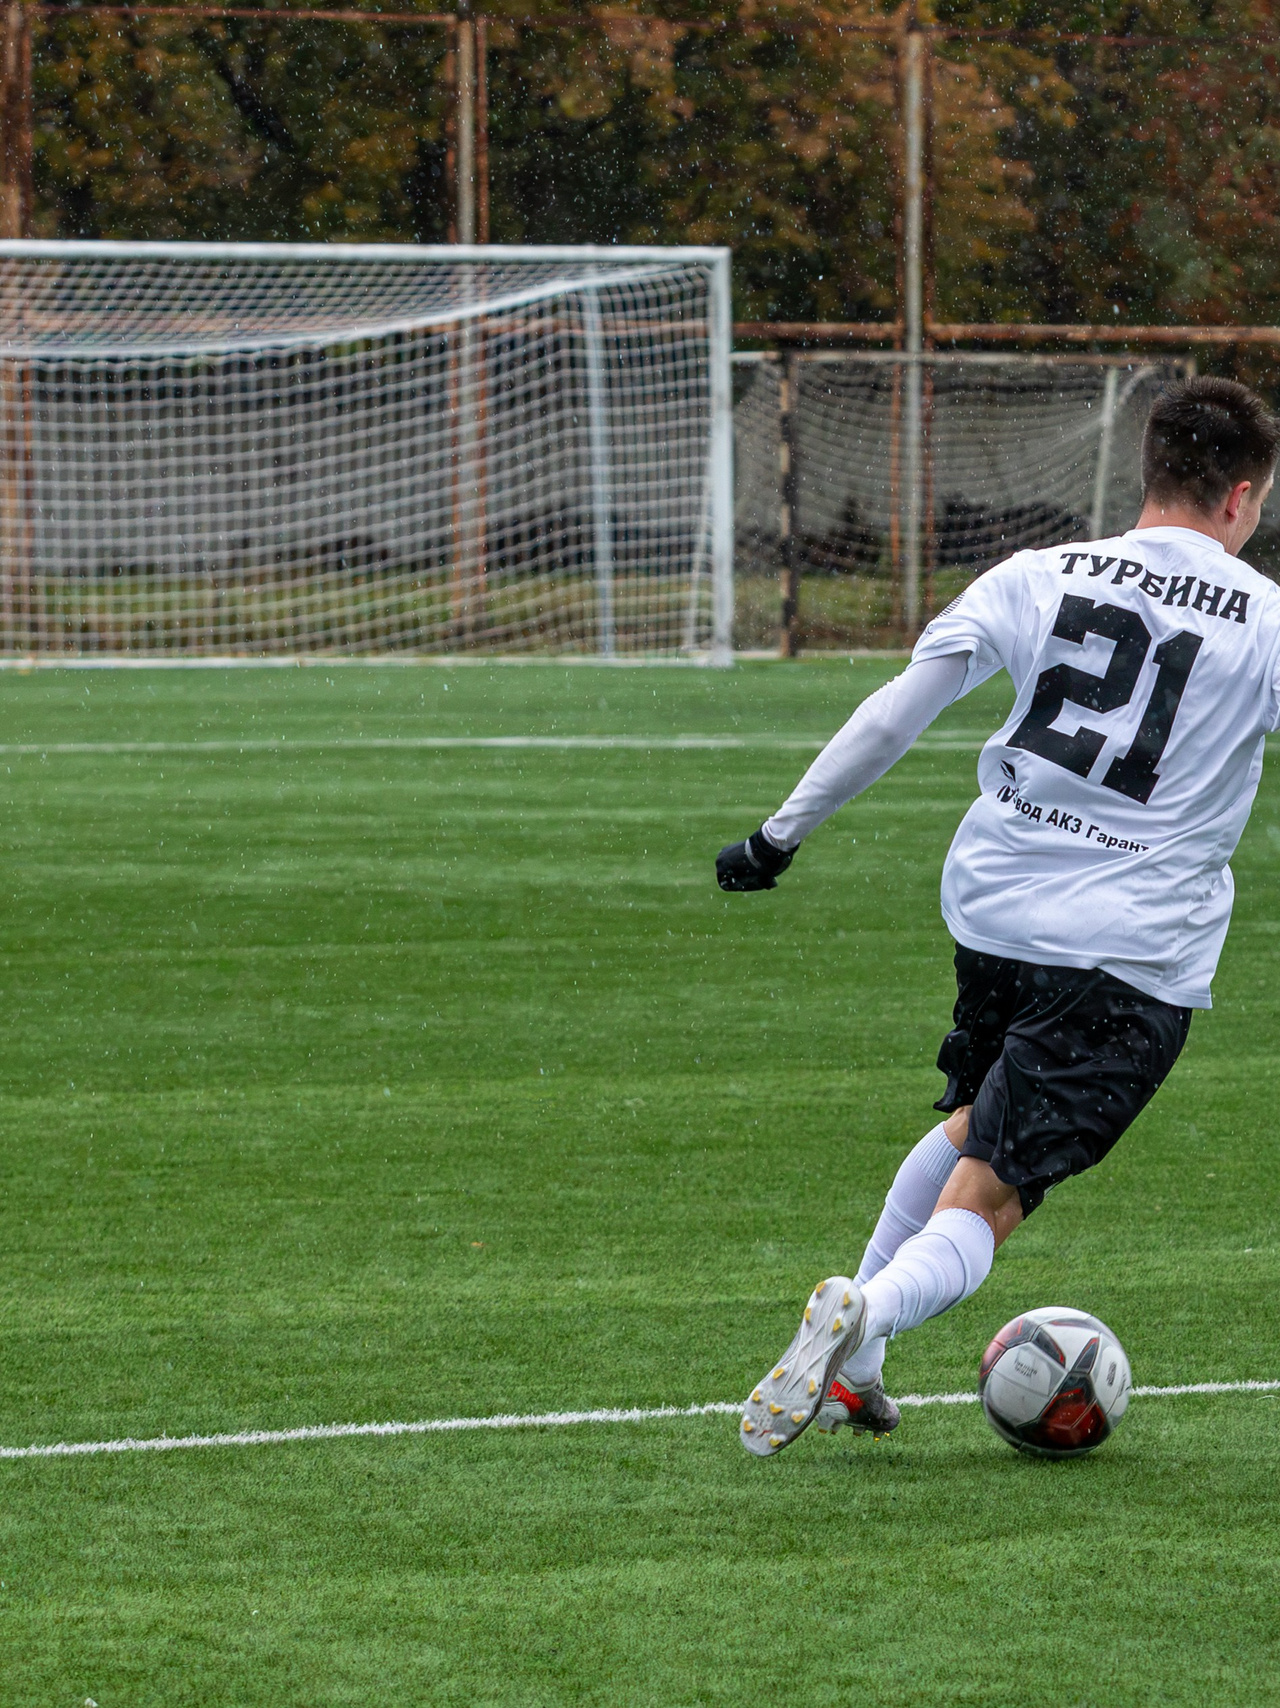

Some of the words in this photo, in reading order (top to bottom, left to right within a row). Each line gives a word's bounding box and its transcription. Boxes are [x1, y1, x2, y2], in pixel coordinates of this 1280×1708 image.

[1060, 553, 1250, 624] ТУРБИНА
[1004, 593, 1204, 805] 21
[1013, 792, 1043, 823] вод
[1045, 808, 1083, 834] АКЗ
